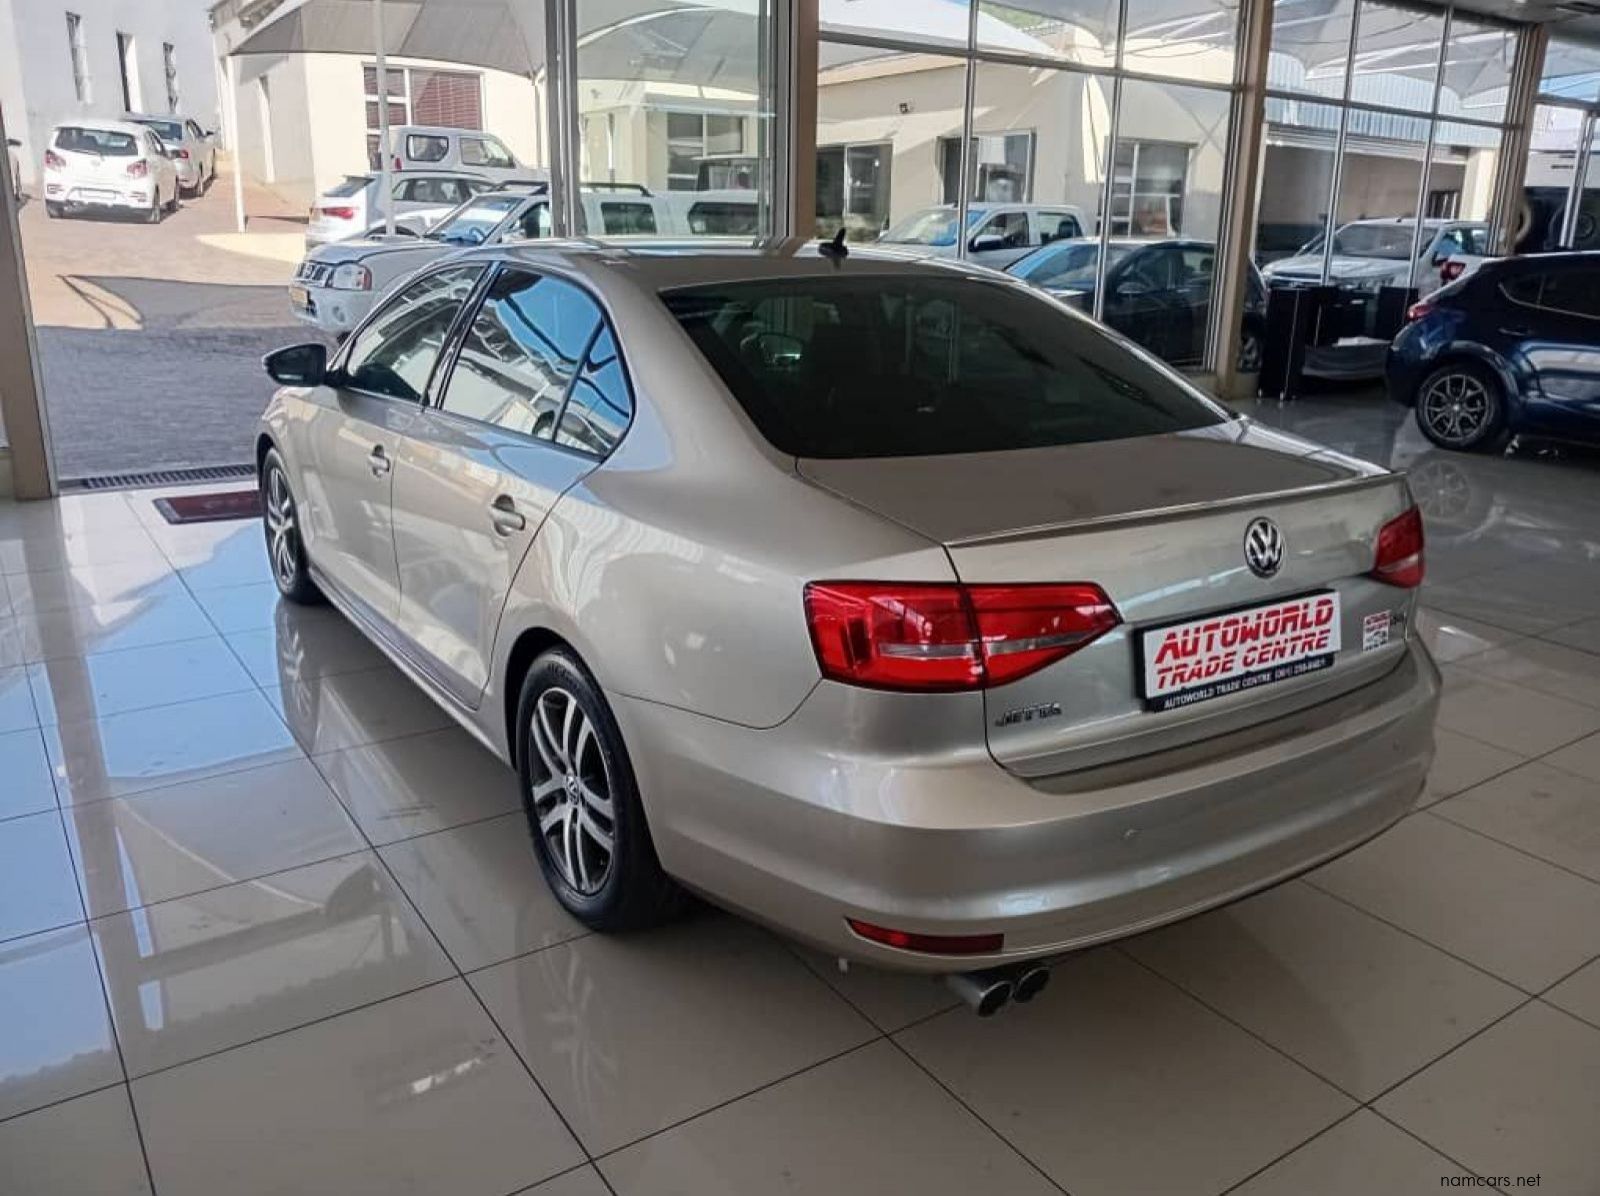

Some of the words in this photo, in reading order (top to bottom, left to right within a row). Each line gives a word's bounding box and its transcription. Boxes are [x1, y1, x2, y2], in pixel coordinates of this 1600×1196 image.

[1155, 598, 1334, 664] AUTOWORLD
[1157, 651, 1237, 689] TRADE
[1242, 629, 1331, 667] CENTRE
